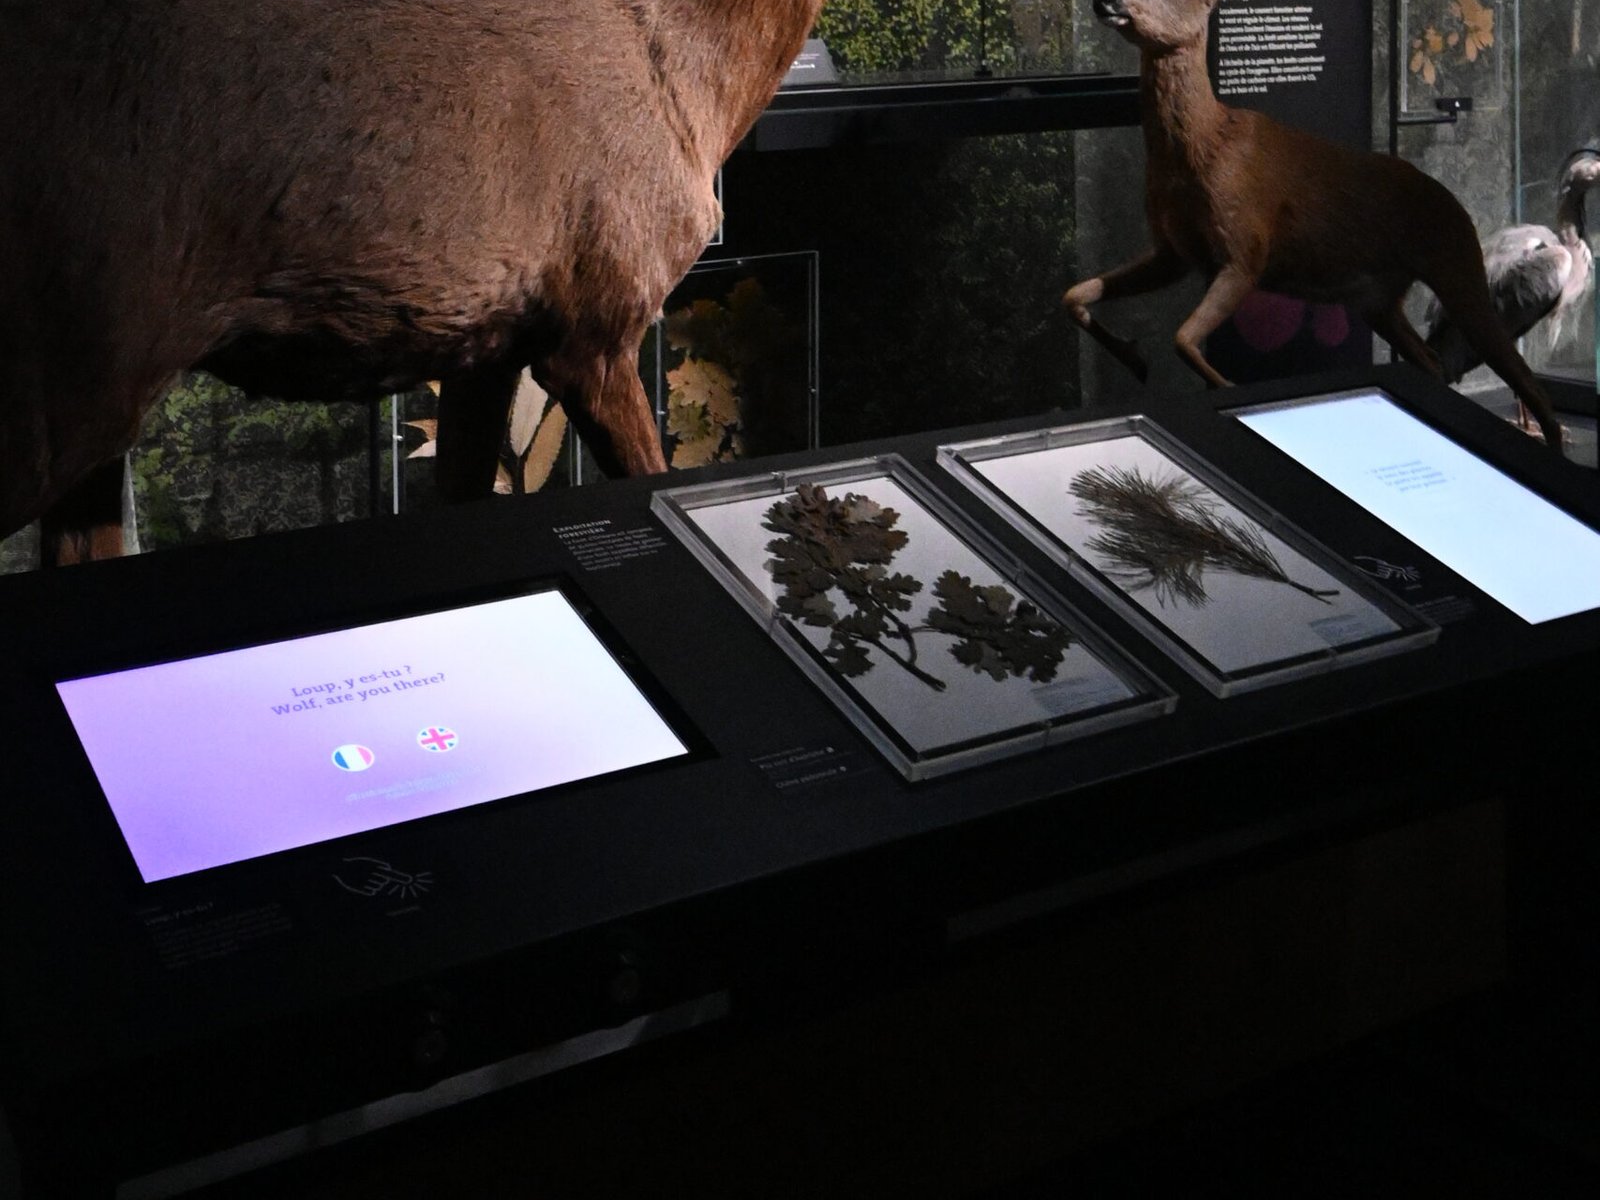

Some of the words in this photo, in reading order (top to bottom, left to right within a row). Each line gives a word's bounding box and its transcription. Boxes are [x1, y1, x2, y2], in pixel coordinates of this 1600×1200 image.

[271, 697, 323, 716] Wolf,
[325, 693, 354, 705] are
[357, 686, 391, 702] you
[393, 672, 447, 692] there?
[291, 682, 342, 697] Loup,
[344, 678, 355, 689] y
[359, 668, 402, 683] es-tu
[403, 665, 412, 675] ?
